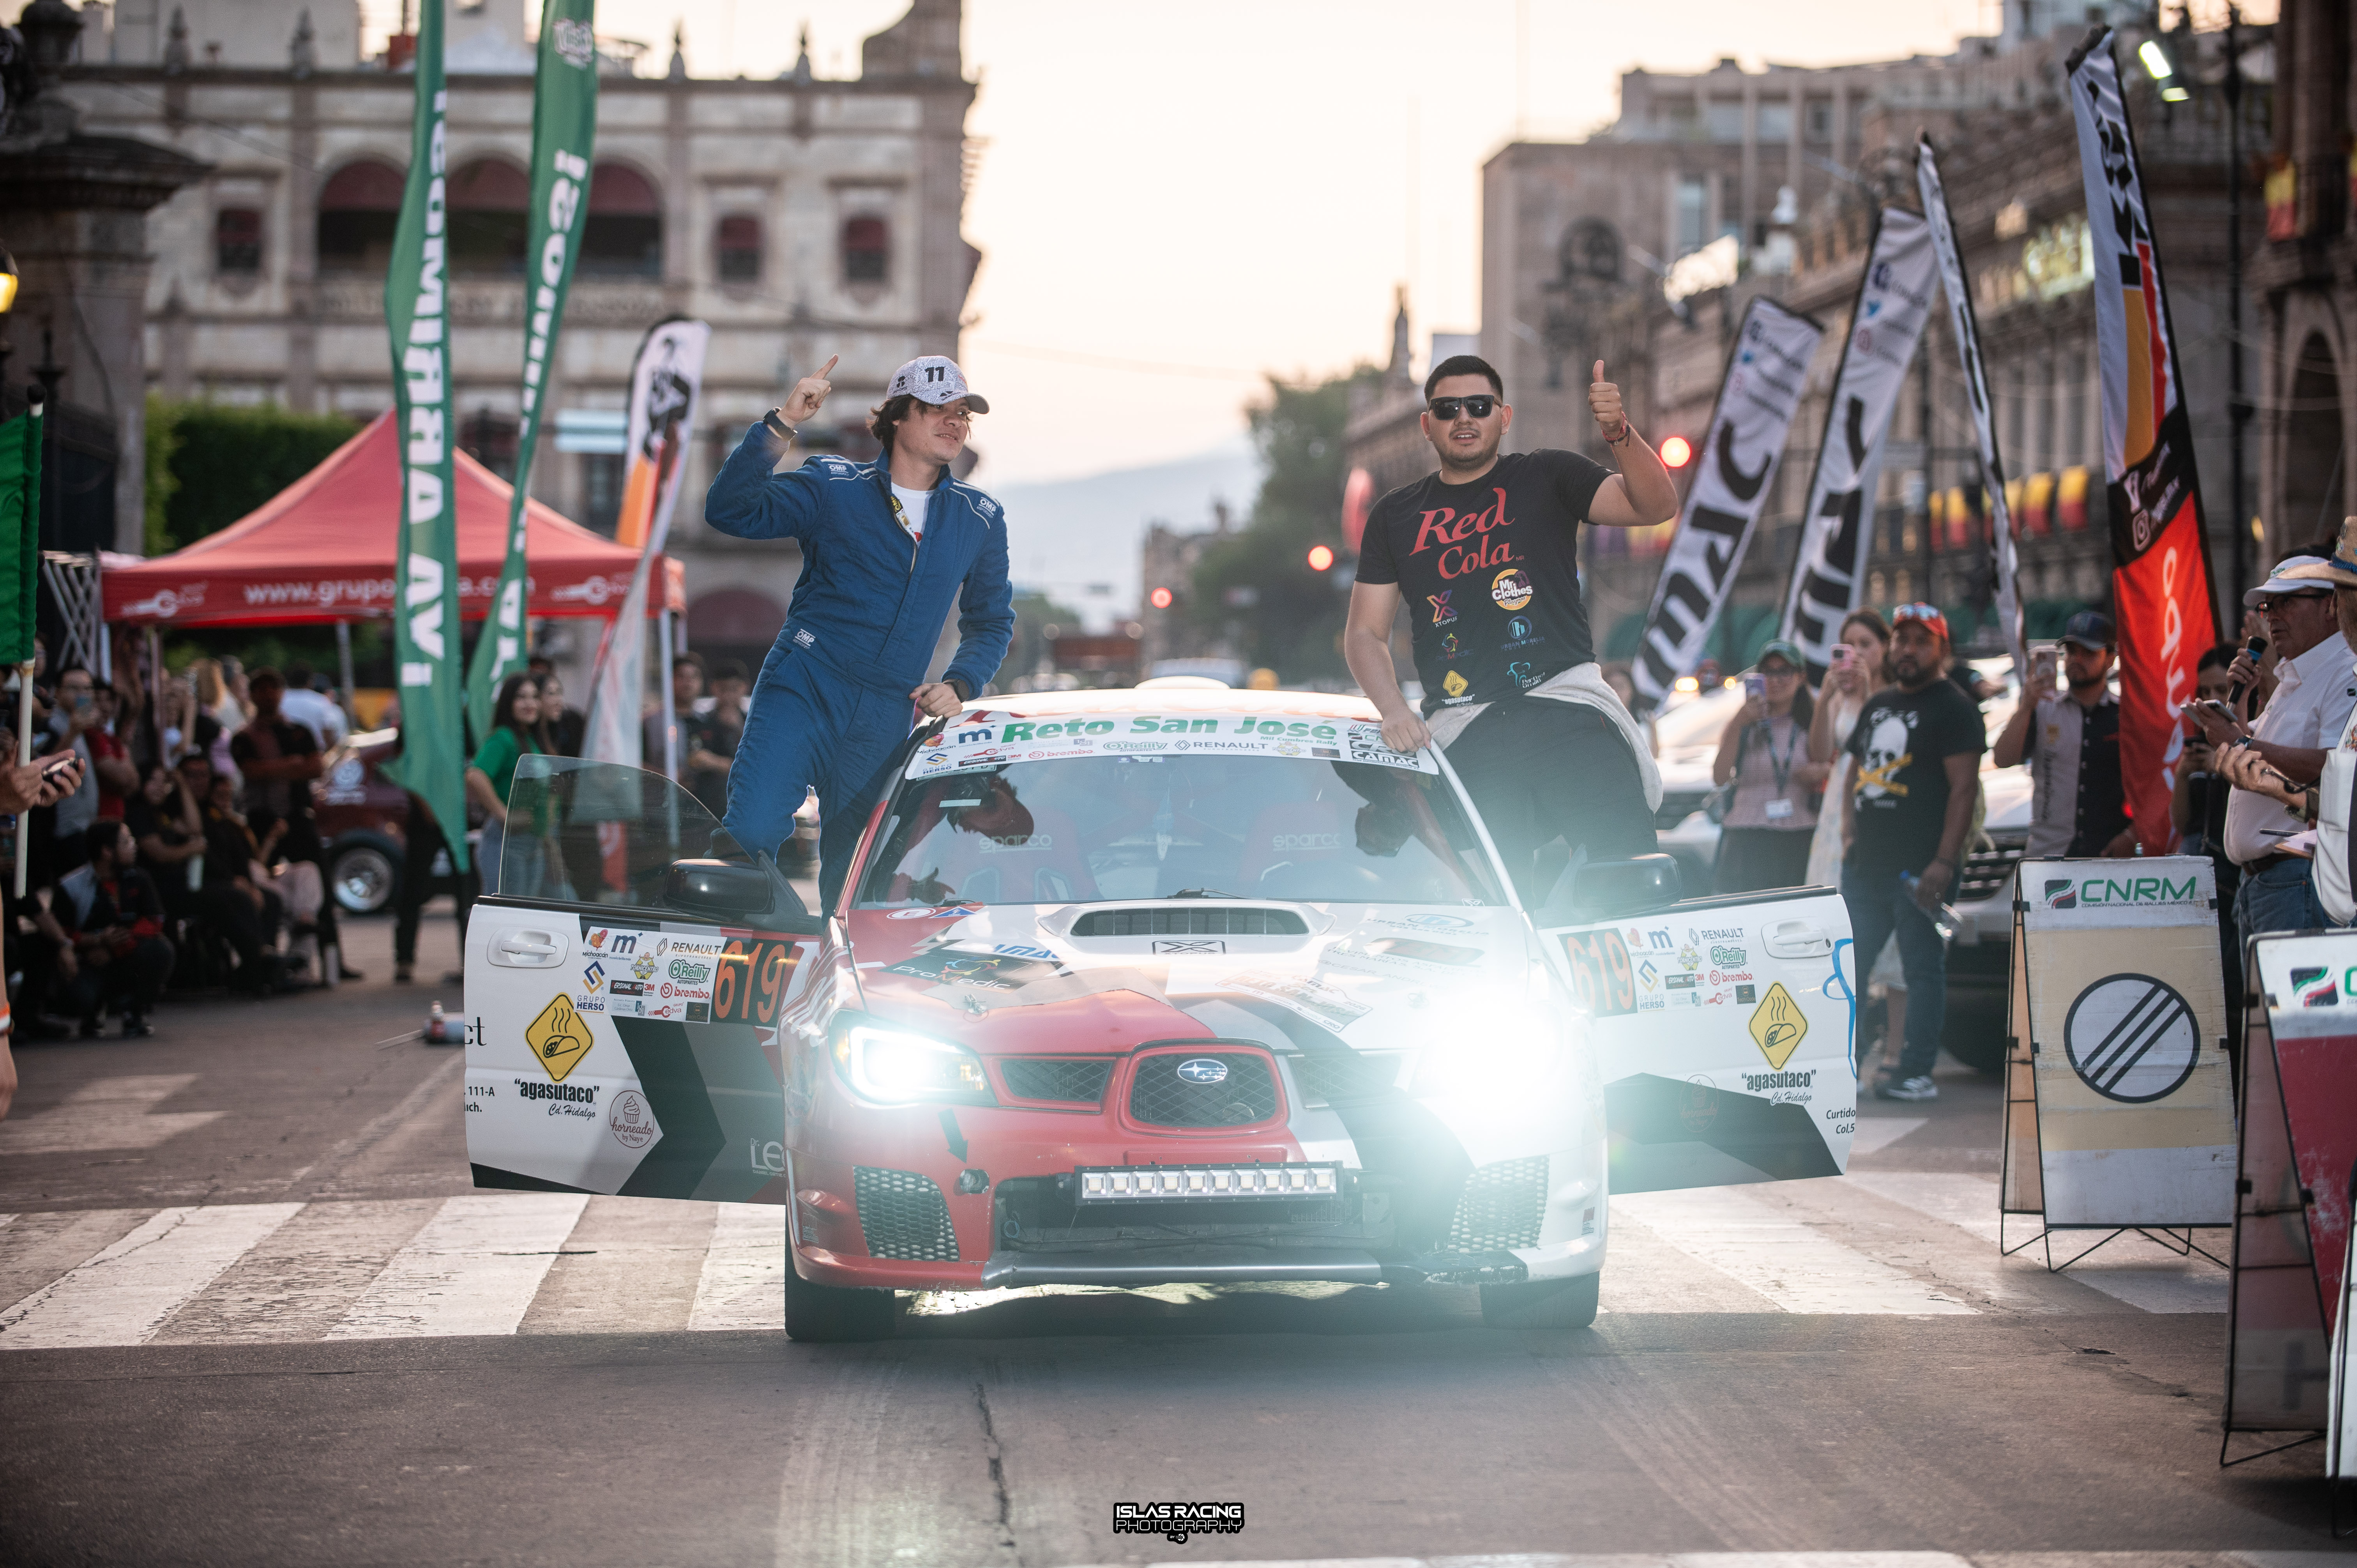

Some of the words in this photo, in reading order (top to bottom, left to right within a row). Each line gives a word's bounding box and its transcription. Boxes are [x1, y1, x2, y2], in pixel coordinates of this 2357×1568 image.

[925, 366, 945, 383] 11
[980, 499, 996, 512] OMP
[1409, 487, 1516, 556] Red
[1438, 535, 1514, 579] Cola
[1499, 579, 1514, 590] Mr.
[1492, 583, 1533, 600] Clothes
[1435, 616, 1457, 628] XTOPUS
[797, 630, 815, 644] OMP
[1001, 717, 1115, 743] Reto
[1130, 716, 1218, 733] San
[1234, 716, 1337, 739] José
[917, 745, 956, 754] Michoacán
[1353, 751, 1419, 768] CAMAC
[979, 833, 1051, 850] sparco
[2080, 876, 2196, 902] CNRM
[1701, 928, 1744, 940] RENAULT
[582, 950, 608, 958] Michoacán
[671, 942, 721, 955] RENAULT
[1712, 947, 1745, 964] O'Reilly
[630, 964, 659, 972] TORNICENTRO
[670, 960, 709, 980] O'Reilly
[1567, 932, 1633, 1010] 619
[714, 940, 785, 1023] 619
[892, 966, 1012, 990] ProMedic
[1722, 971, 1752, 982] brembo
[674, 986, 710, 999] brembo
[577, 1002, 604, 1011] HERSO
[1343, 1001, 1367, 1010] 2026
[1640, 1001, 1664, 1010] HERSO
[1323, 1019, 1340, 1029] CRO
[468, 1086, 495, 1097] 111-A
[1771, 1091, 1783, 1105] Cd.
[1784, 1091, 1811, 1105] Hidalgo
[549, 1103, 562, 1116] Cd.
[563, 1105, 596, 1121] Hidalgo
[1826, 1107, 1856, 1119] Curtido
[612, 1116, 652, 1135] horneado
[622, 1134, 629, 1142] by
[629, 1135, 643, 1143] Naye
[751, 1138, 760, 1146] Dr.
